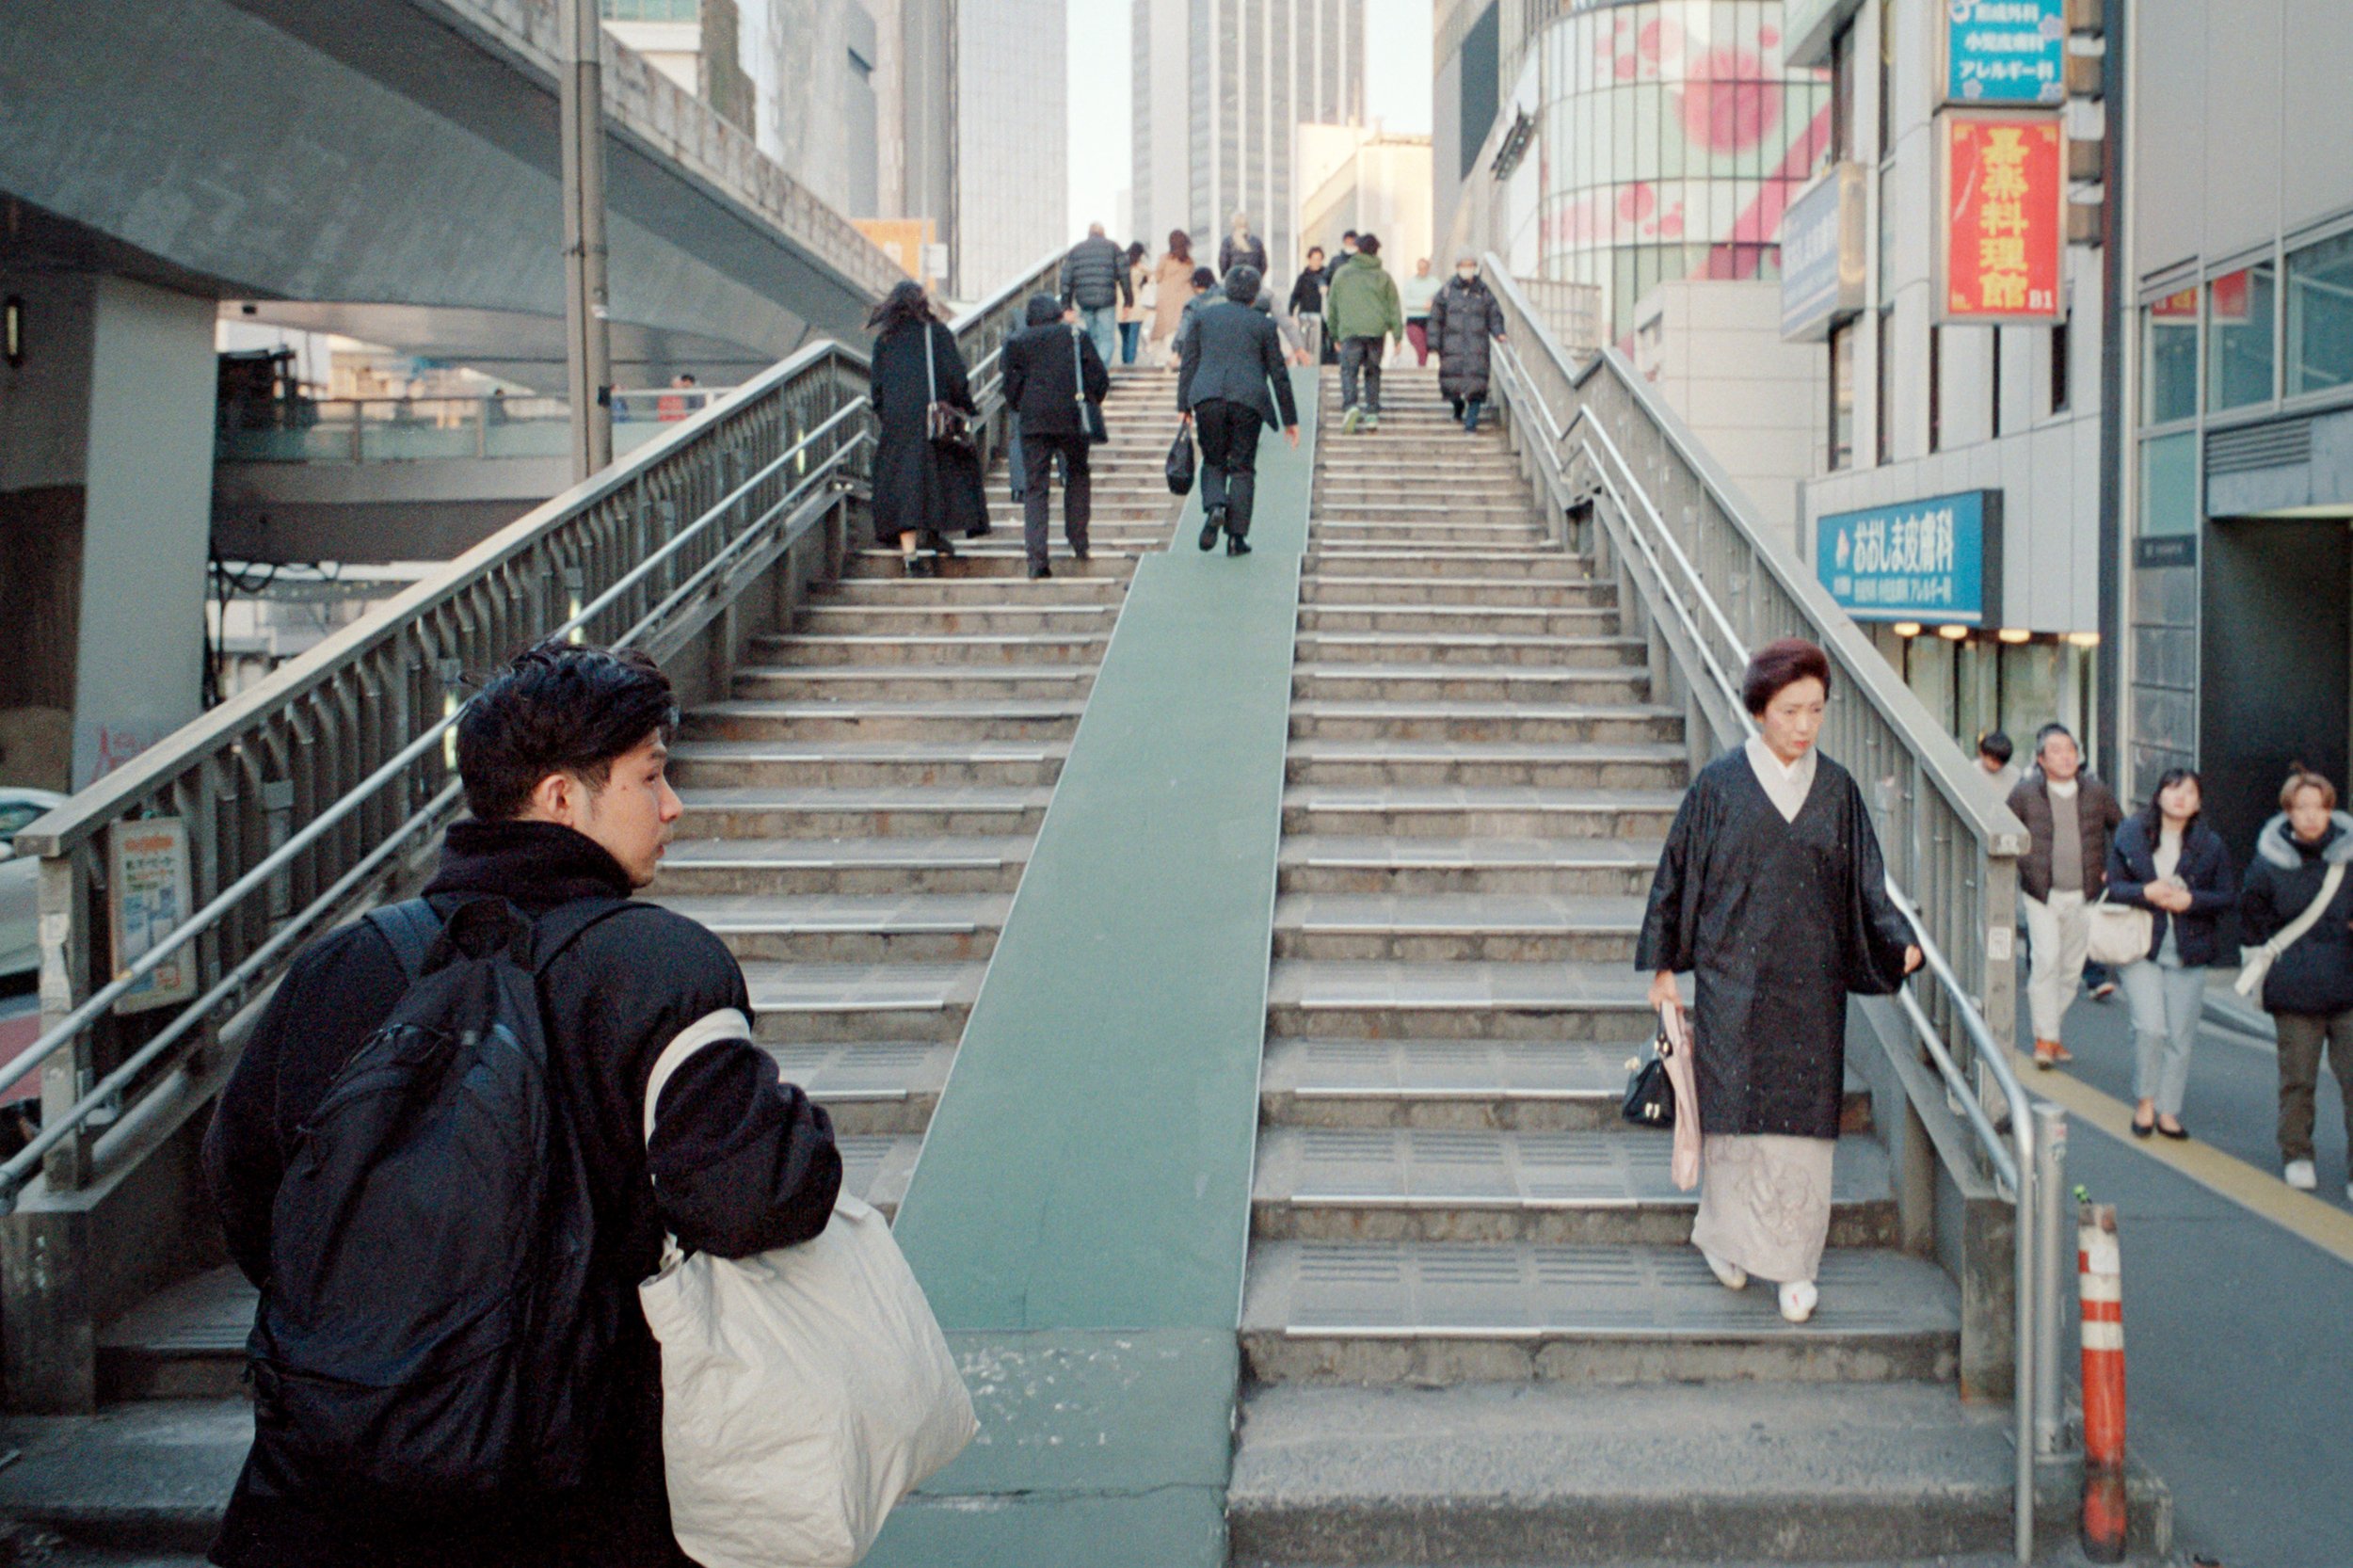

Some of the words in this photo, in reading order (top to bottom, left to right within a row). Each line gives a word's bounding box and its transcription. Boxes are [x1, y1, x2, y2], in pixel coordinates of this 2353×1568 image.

[1853, 508, 1953, 573] おおしま皮膚科
